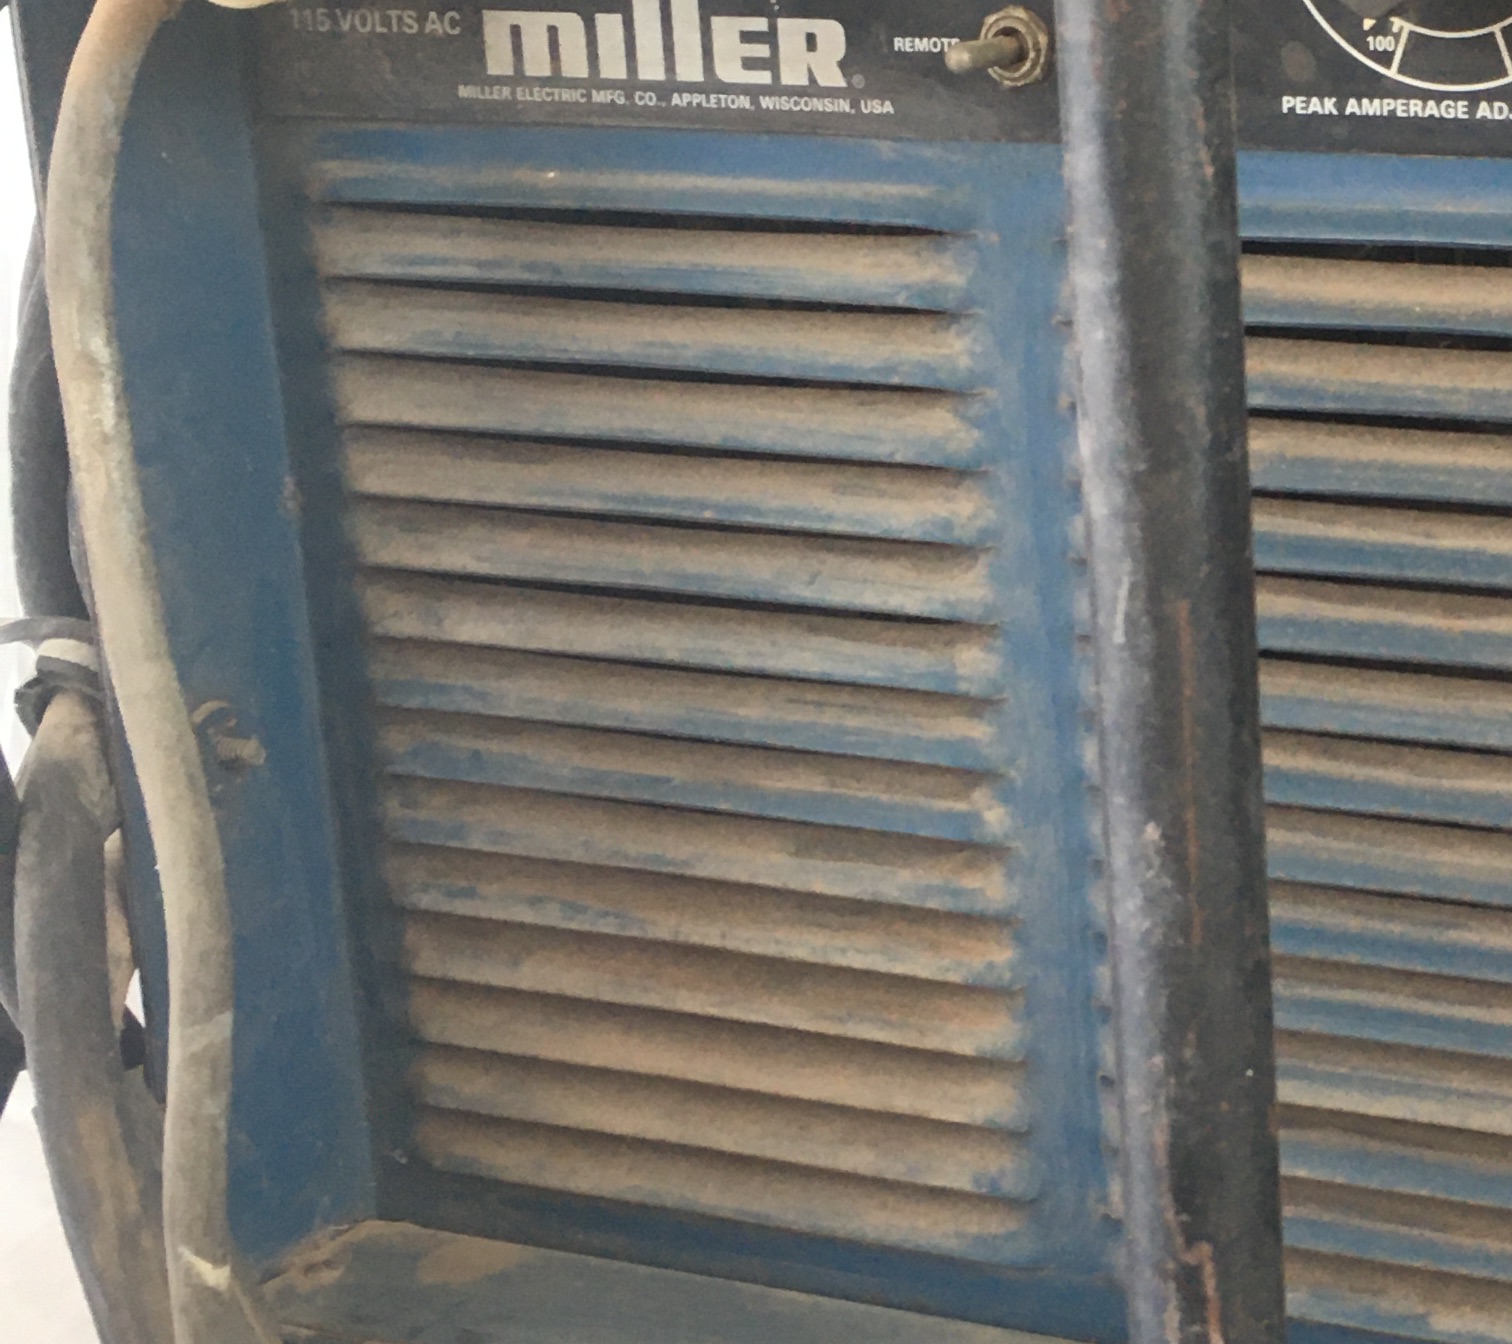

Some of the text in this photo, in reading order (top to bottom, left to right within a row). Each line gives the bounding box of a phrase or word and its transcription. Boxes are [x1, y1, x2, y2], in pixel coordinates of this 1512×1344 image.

[289, 8, 462, 36] 115 VOLTS AC
[1367, 35, 1396, 52] 100
[458, 84, 512, 101] MILLER
[516, 86, 586, 104] ELECTRIC
[592, 89, 629, 105] MFG.
[671, 92, 755, 111] APPLETON,
[759, 95, 856, 115] WISCONSIN,
[861, 99, 895, 116] USA
[1281, 95, 1339, 116] PEAK
[1344, 97, 1470, 120] AMPERAGE
